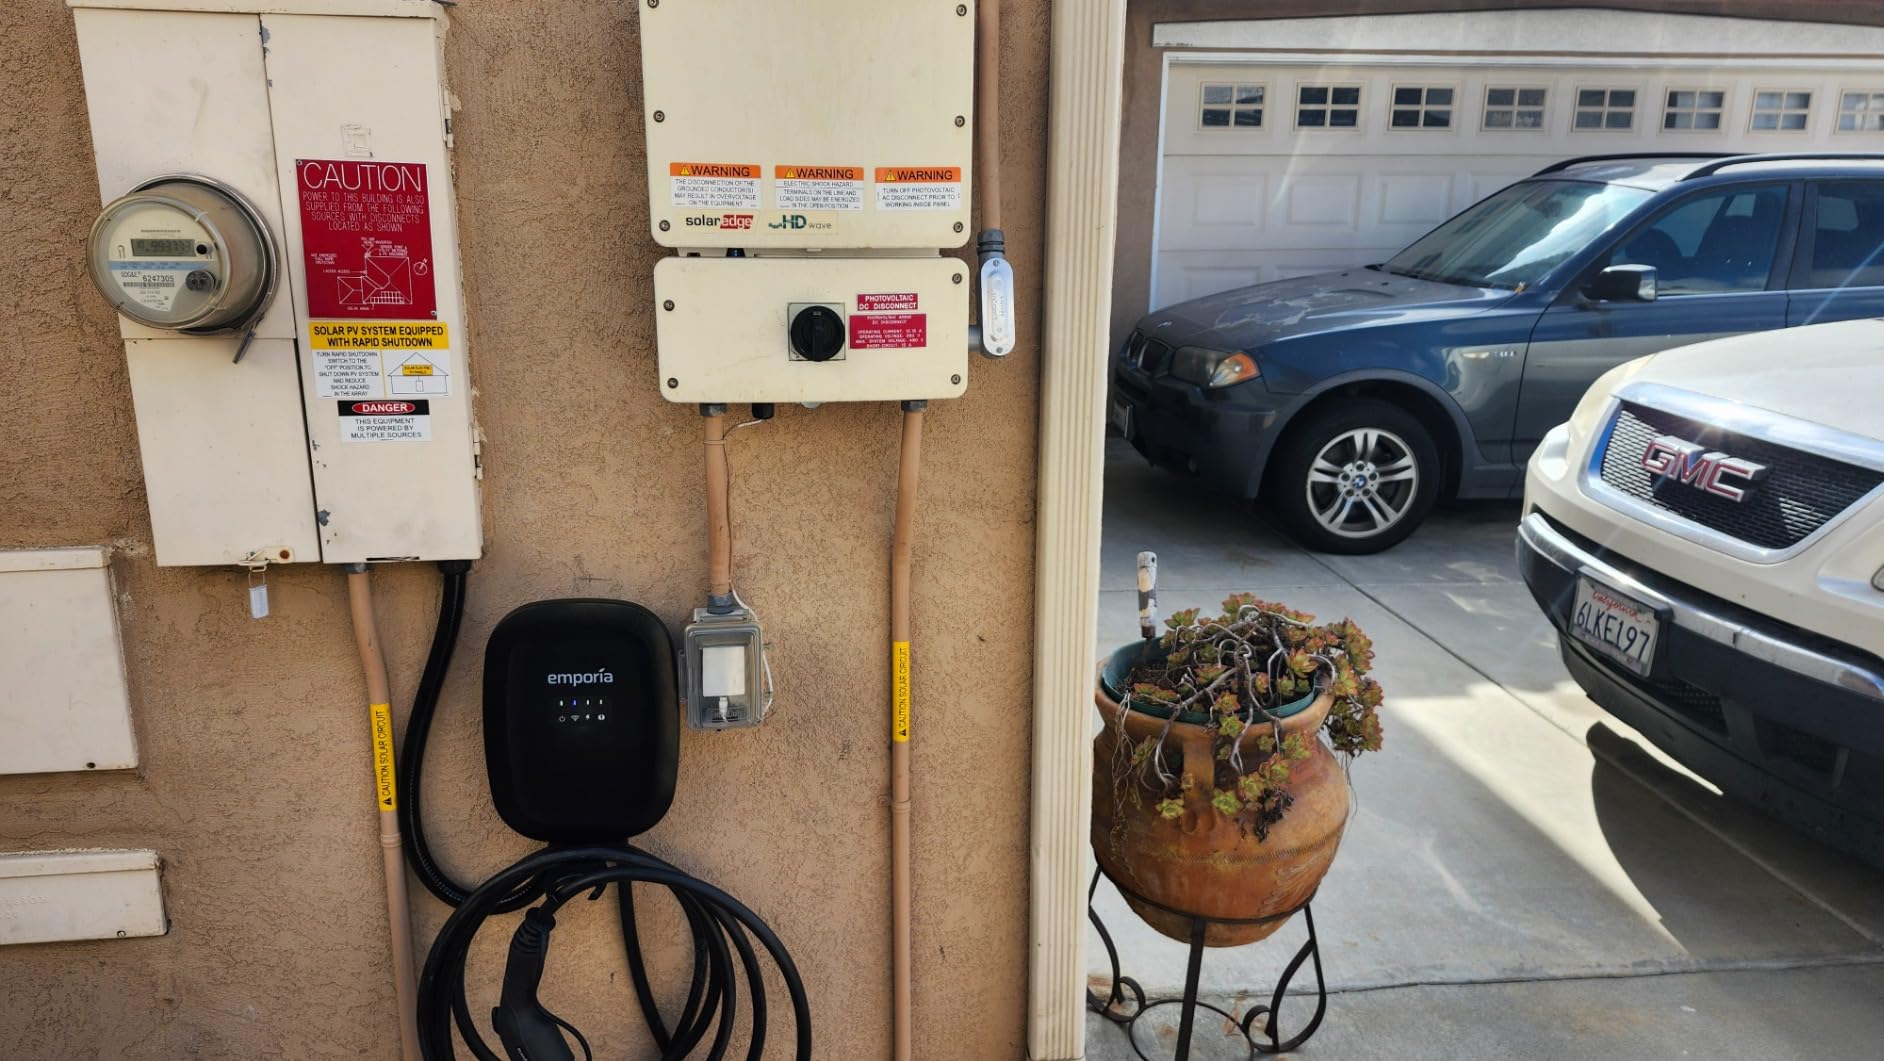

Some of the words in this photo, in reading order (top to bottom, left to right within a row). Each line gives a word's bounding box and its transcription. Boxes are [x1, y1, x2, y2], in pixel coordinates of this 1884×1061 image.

[303, 162, 421, 192] CAUTION
[691, 166, 750, 176] WARNING
[796, 168, 853, 179] WARNING
[898, 170, 952, 180] WARNING
[303, 192, 327, 200] POWER
[332, 192, 339, 200] TO
[344, 193, 358, 202] THIS
[362, 193, 392, 203] BUILDING
[397, 195, 403, 203] IS
[407, 195, 424, 204] ALSO
[306, 202, 339, 211] SUPPLIED
[344, 203, 363, 212] FROM
[368, 203, 379, 212] THE
[384, 204, 424, 214] FOLLOWING
[312, 212, 345, 221] SOURCES
[350, 213, 366, 221] WITH
[370, 214, 419, 223] DISCONNECTS
[686, 214, 753, 229] solaredge
[782, 215, 806, 229] HD
[329, 221, 359, 231] LOCATED
[364, 223, 373, 231] AS
[377, 223, 403, 232] SHOWN
[314, 327, 344, 335] SOLAR
[348, 327, 358, 335] PV
[361, 327, 396, 335] SYSTEM
[400, 326, 443, 336] EQUIPPED
[328, 338, 350, 346] WITH
[353, 338, 379, 347] RAPID
[382, 338, 432, 347] SHUTDOWN
[362, 404, 408, 412] DANGER
[1641, 439, 1757, 502] GMC
[1576, 601, 1650, 660] 6LKE197
[899, 648, 907, 673] CIRCUIT
[376, 711, 387, 739] CIRCUIT
[379, 740, 389, 764] SOLAR
[380, 766, 391, 796] CAUTION
